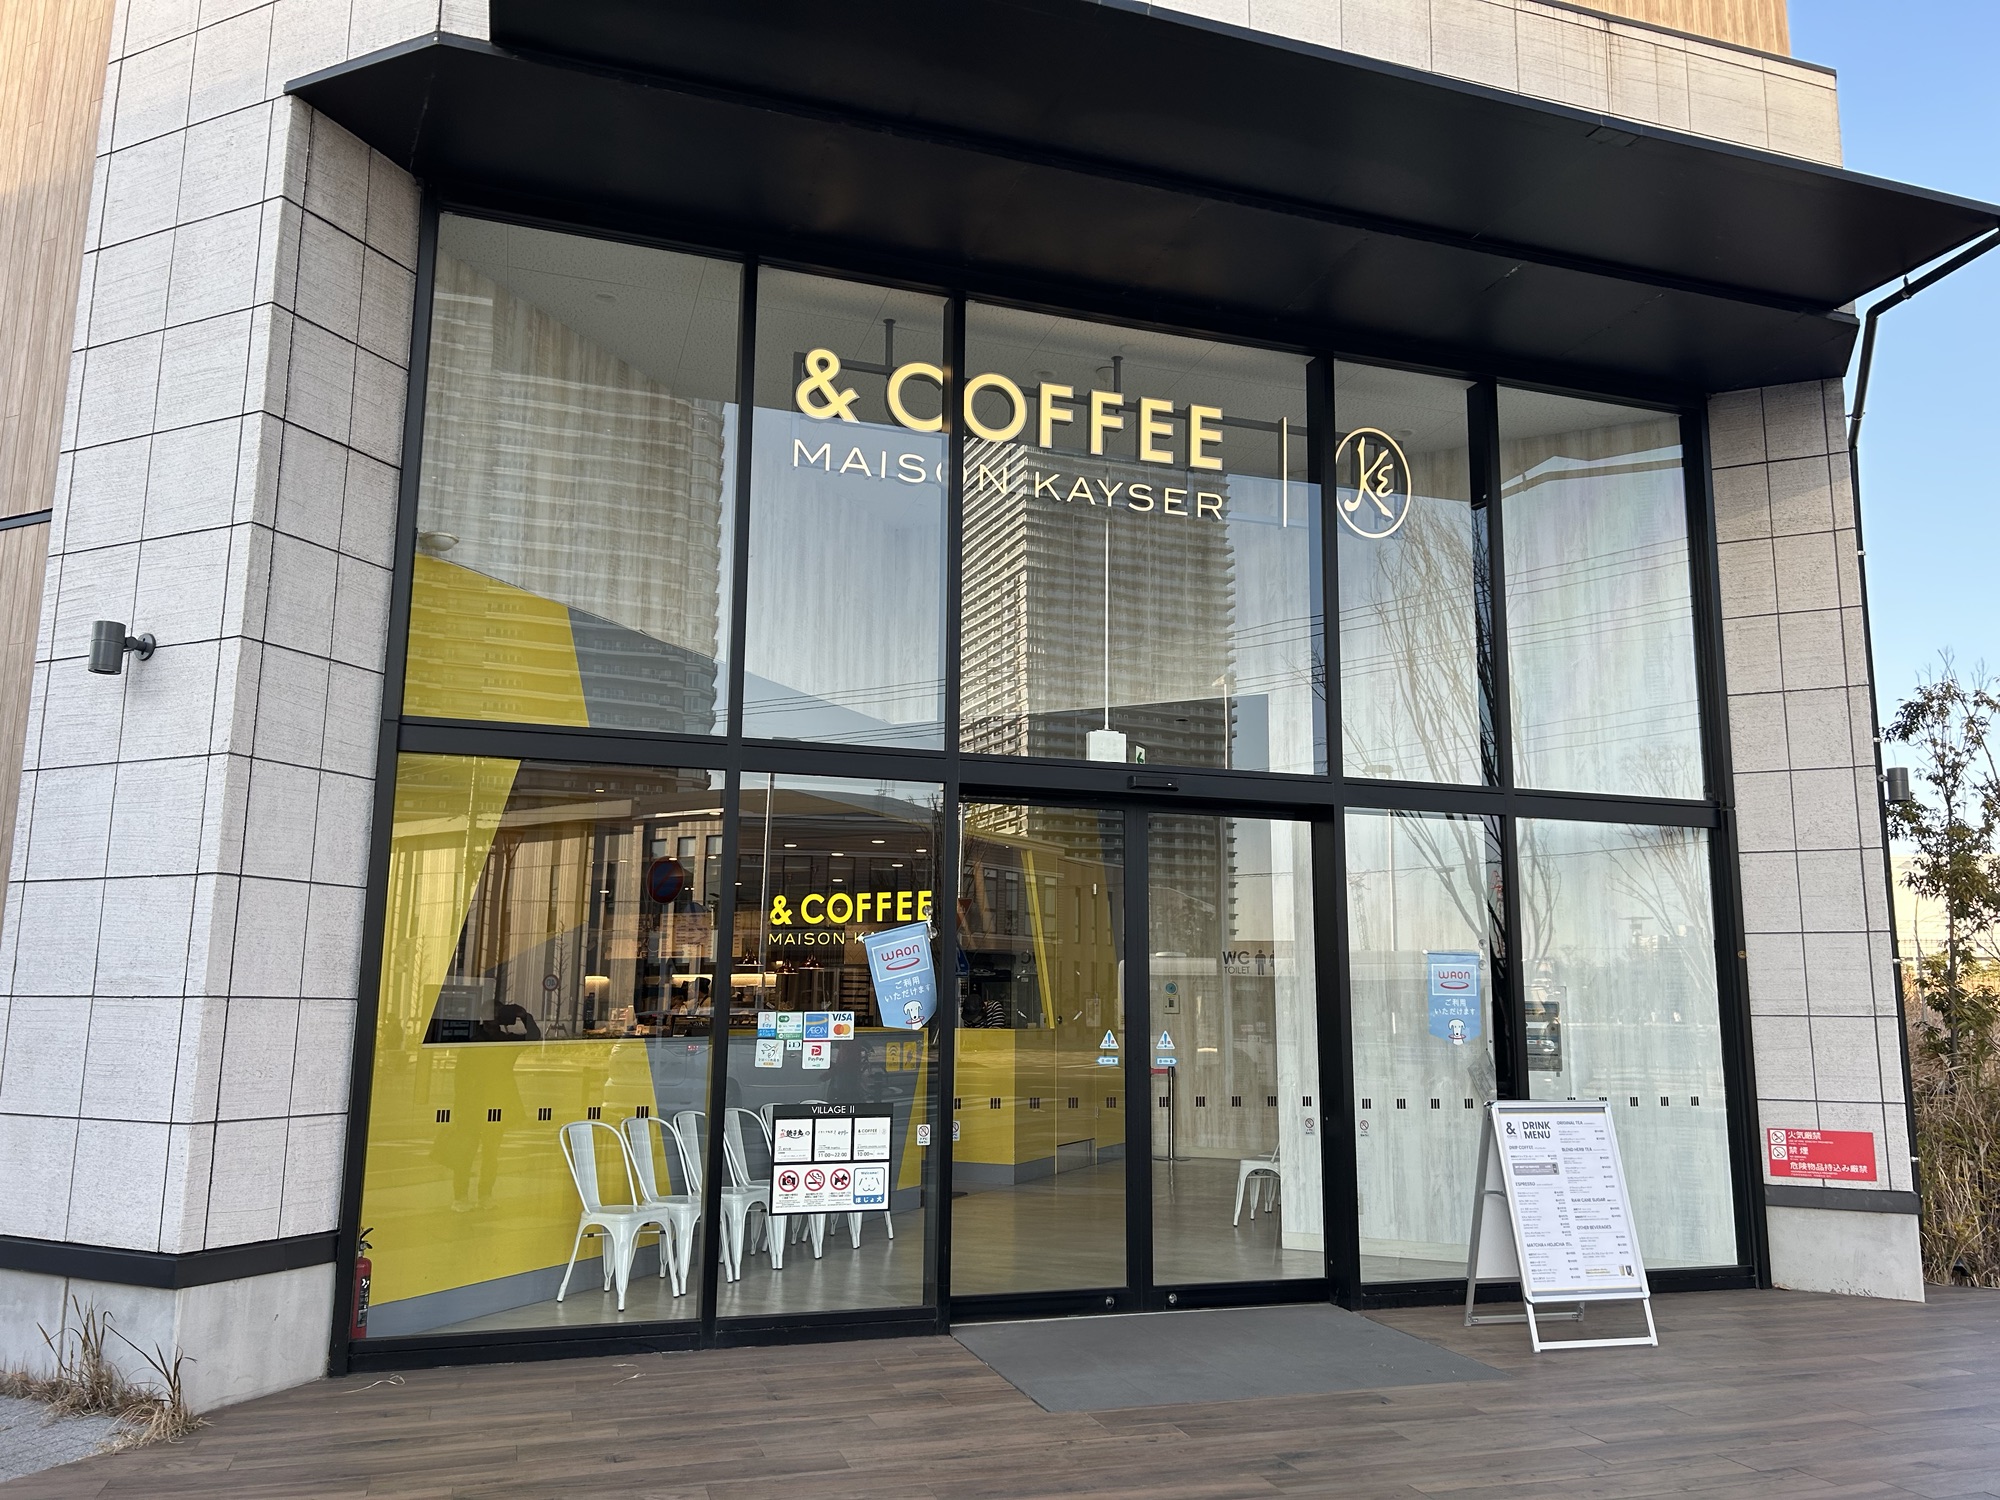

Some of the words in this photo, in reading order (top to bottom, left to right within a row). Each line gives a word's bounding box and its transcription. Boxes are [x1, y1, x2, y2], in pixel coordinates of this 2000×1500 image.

[795, 348, 862, 423] &
[886, 361, 1225, 470] COFFEE
[1034, 471, 1225, 520] KAYSER
[769, 894, 793, 926] &
[800, 890, 932, 925] COFFEE
[768, 932, 846, 946] MAISON
[1222, 950, 1250, 965] WC
[1224, 966, 1250, 975] TOILET
[894, 976, 921, 990] ご利用
[884, 983, 932, 1003] いただけます
[1444, 998, 1467, 1008] ご利用
[832, 1013, 853, 1022] VISA
[1434, 1007, 1476, 1016] いただけます
[811, 1105, 846, 1114] VILLAGE
[1506, 1121, 1517, 1135] &
[1522, 1121, 1551, 1130] DRINK
[1524, 1130, 1551, 1139] MENU
[1787, 1130, 1822, 1141] 火気厳禁
[1789, 1161, 1868, 1174] 危険物品持込み厳禁
